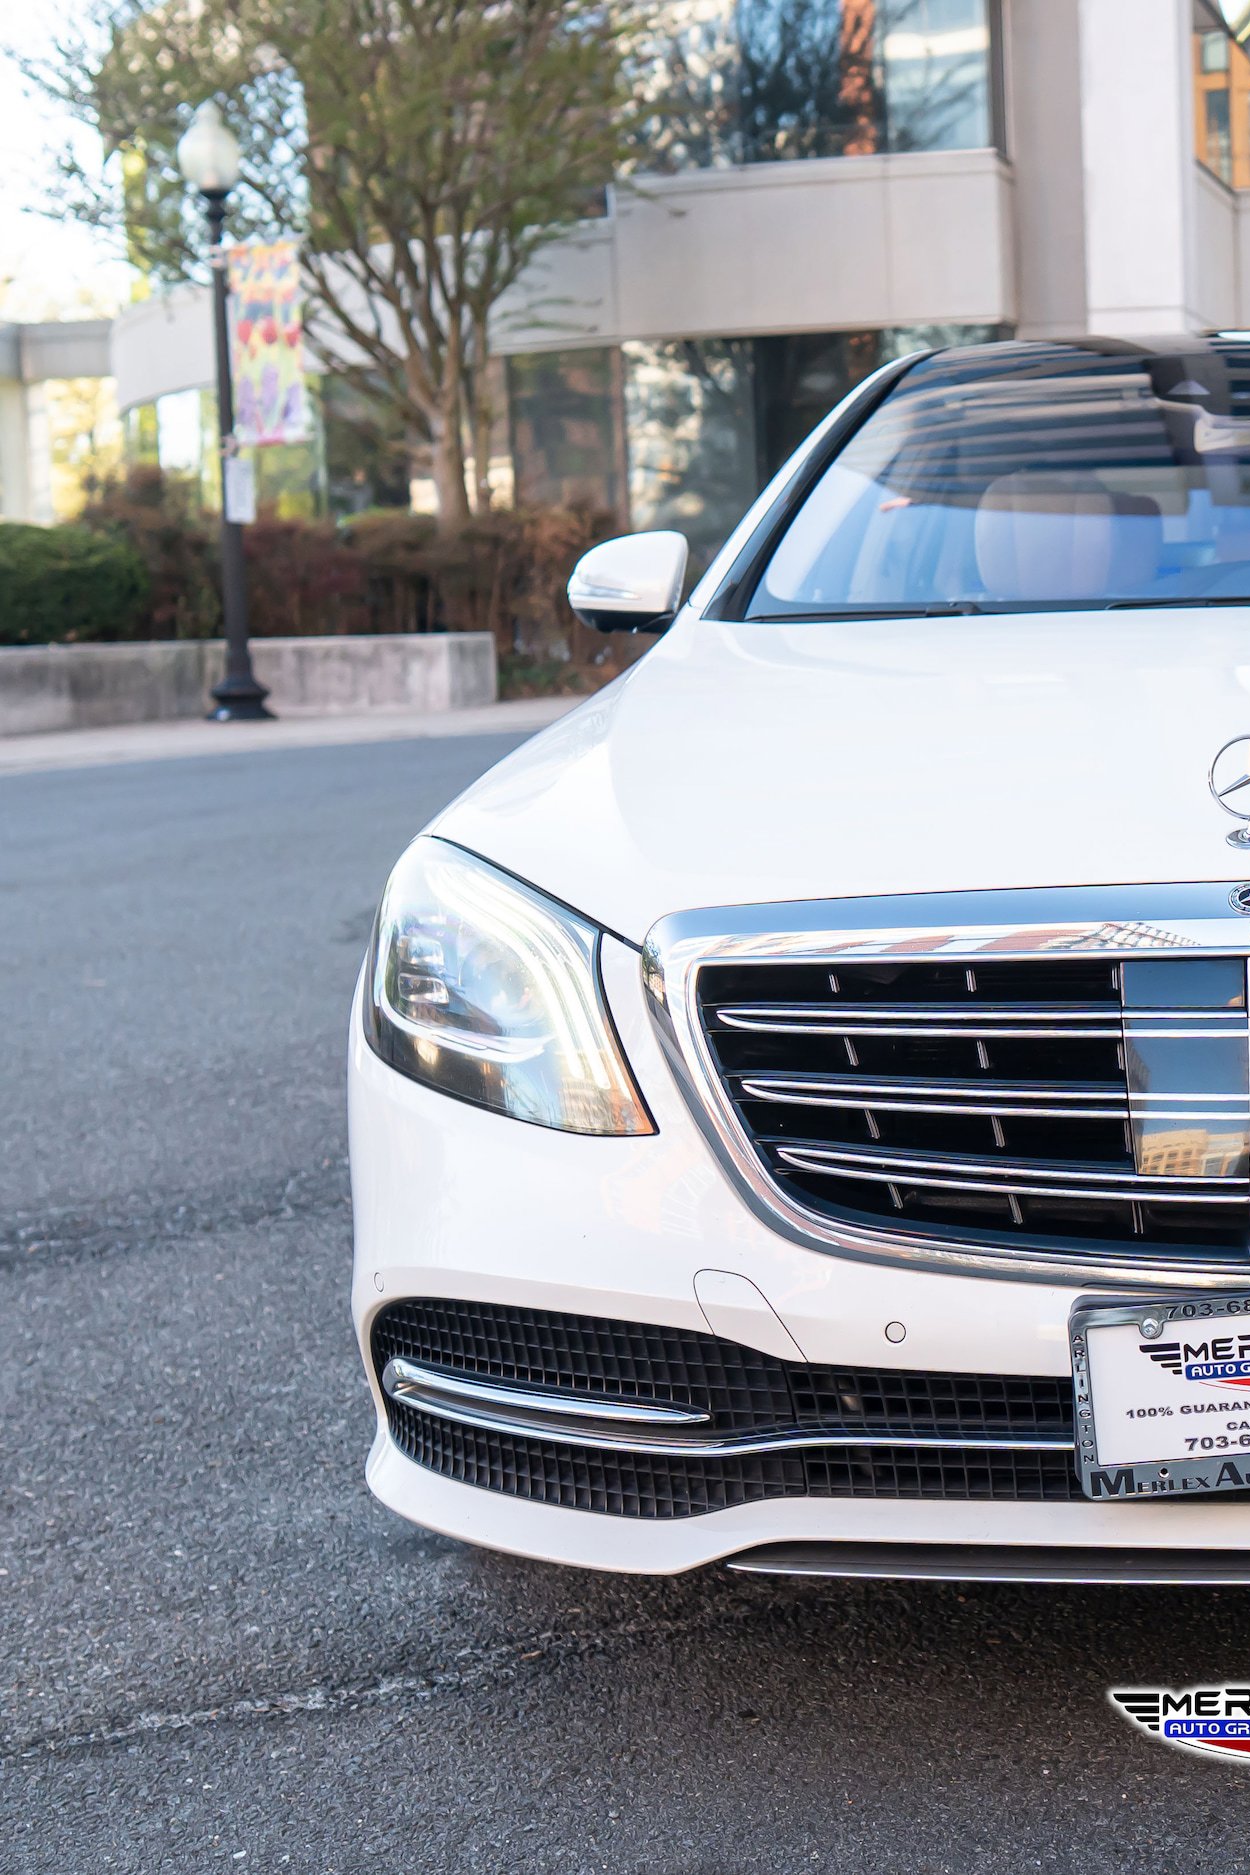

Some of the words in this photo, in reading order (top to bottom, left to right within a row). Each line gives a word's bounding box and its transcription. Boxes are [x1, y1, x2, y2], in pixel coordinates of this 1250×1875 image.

[1191, 1363, 1236, 1377] AUTO
[1072, 1335, 1095, 1464] ARLINGTON
[1125, 1406, 1174, 1419] 100%
